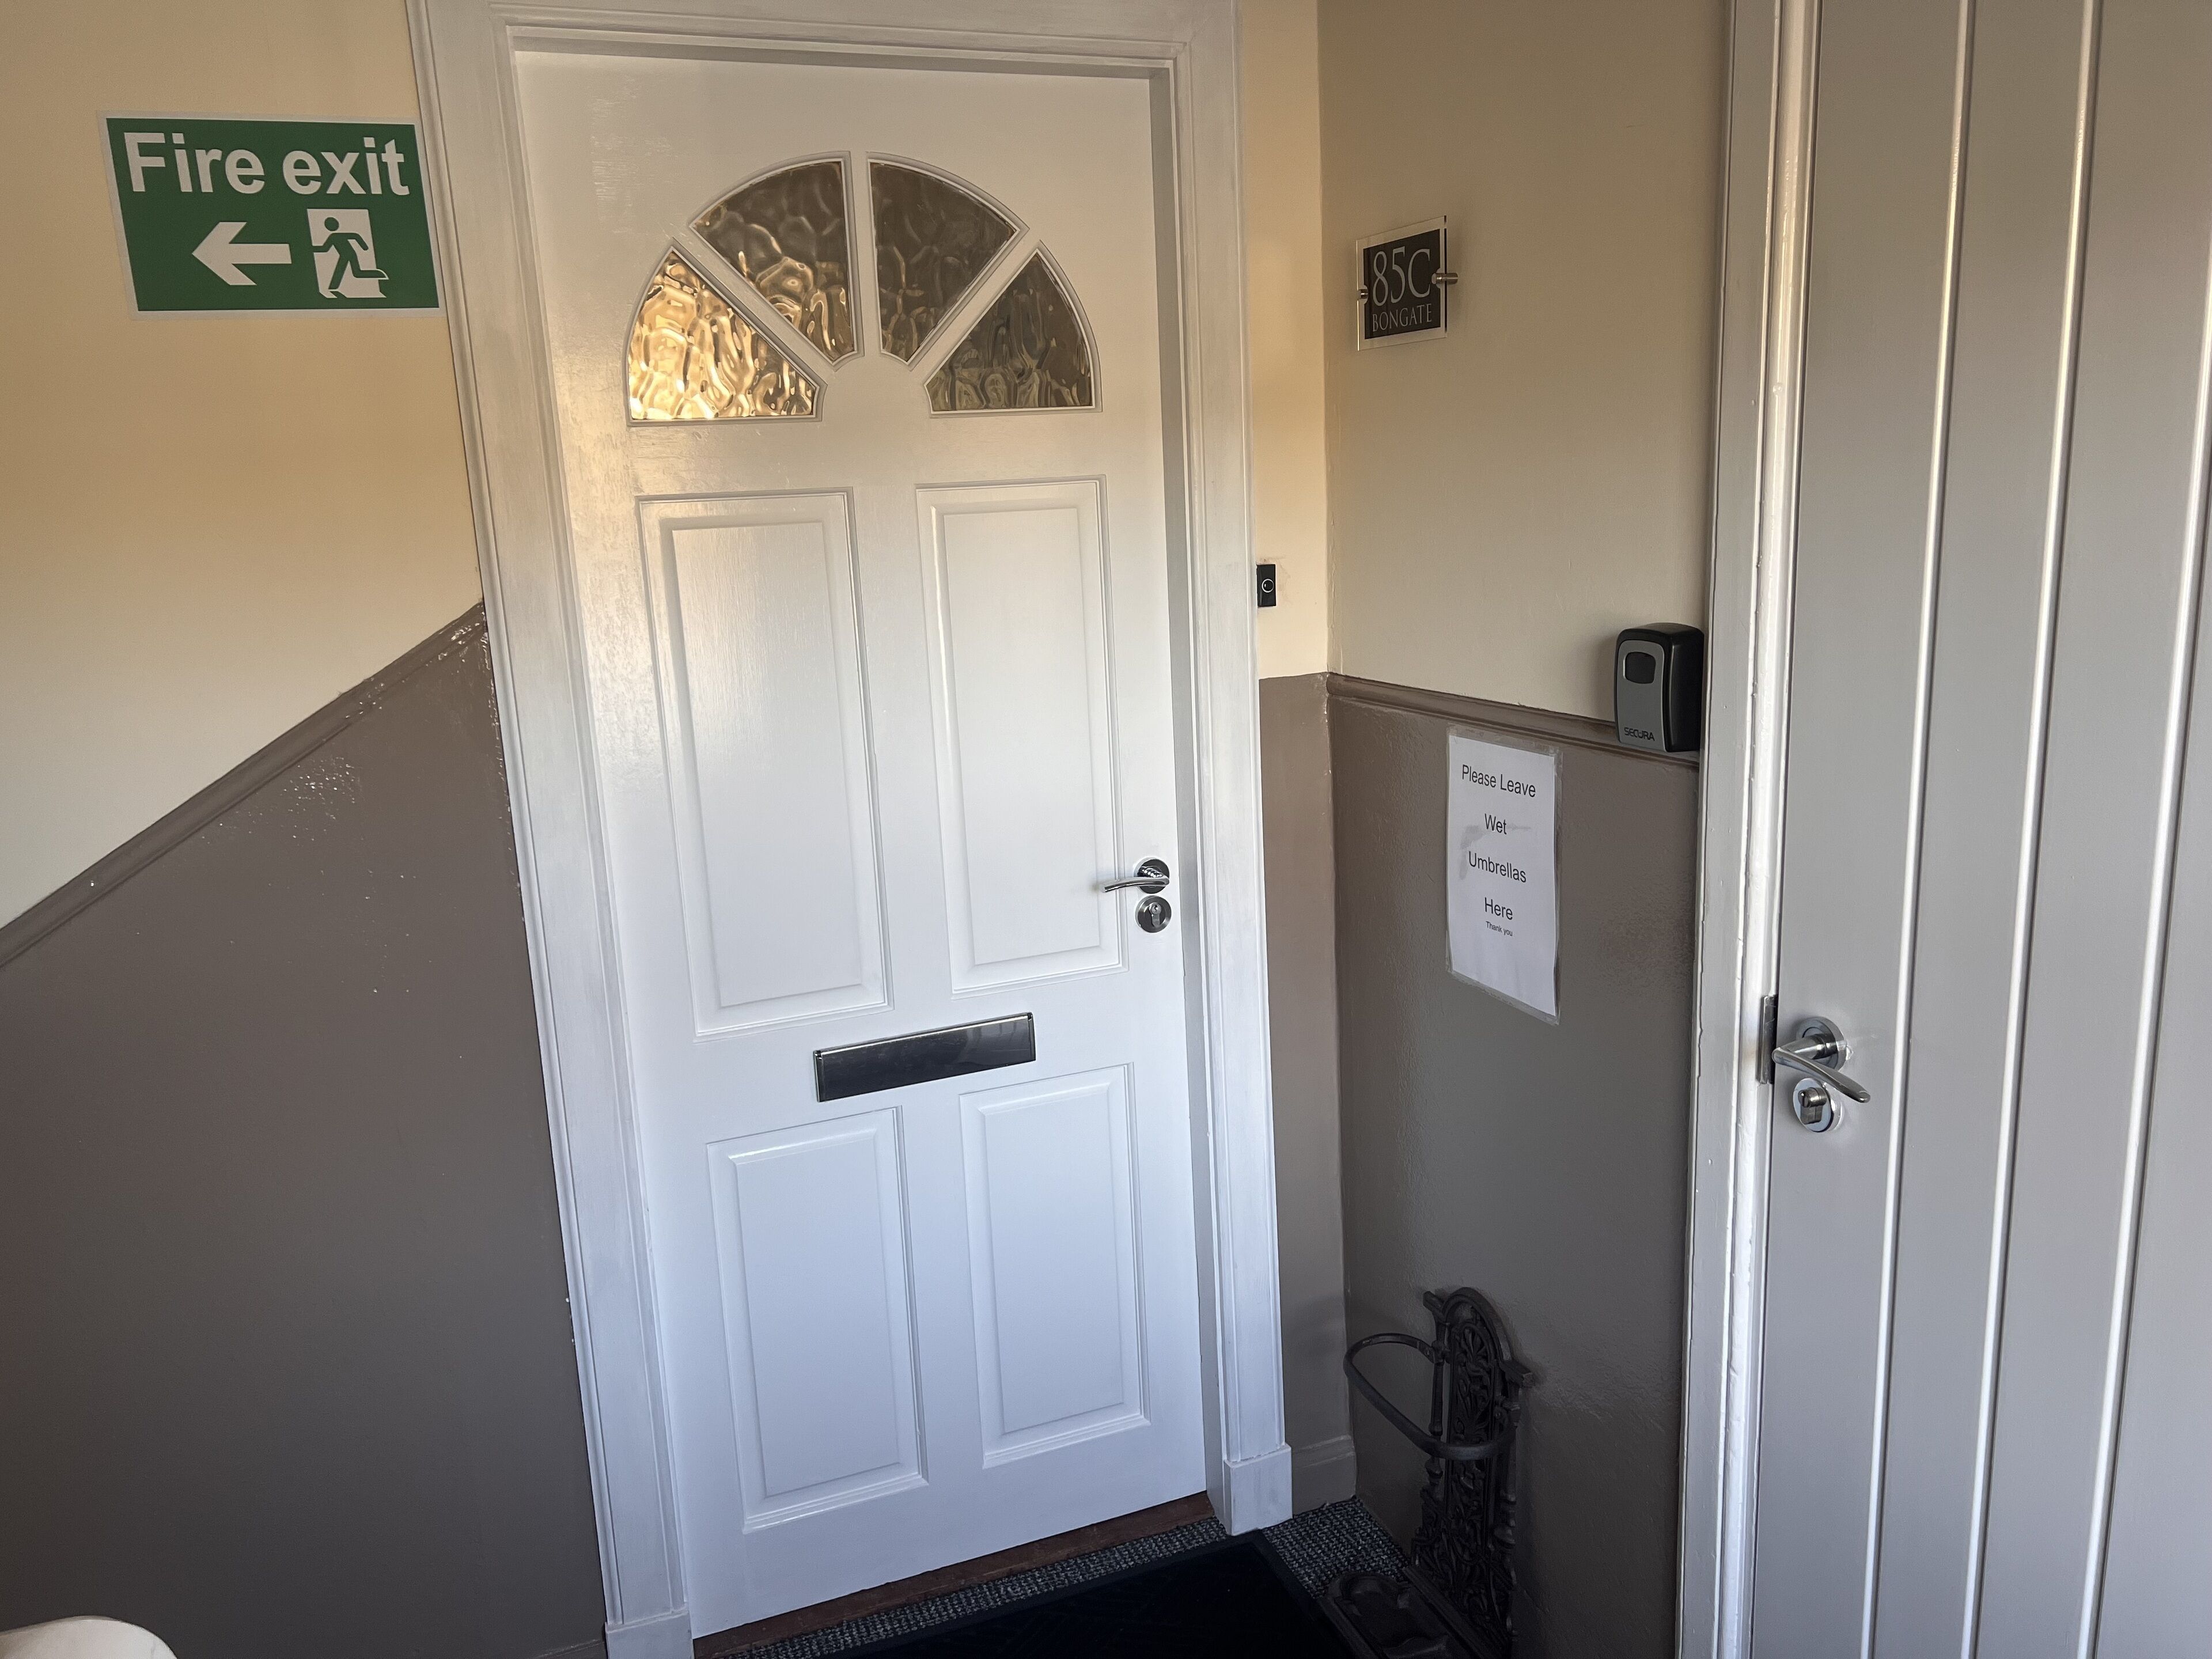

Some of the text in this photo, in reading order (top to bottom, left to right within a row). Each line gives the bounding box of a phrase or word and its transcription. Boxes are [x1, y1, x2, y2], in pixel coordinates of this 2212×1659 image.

[124, 132, 410, 195] Fire exit
[1373, 246, 1431, 306] 85C
[1373, 304, 1432, 332] BONGATE
[1624, 727, 1655, 741] SECURA
[1462, 764, 1536, 797] Please Leave
[1484, 813, 1507, 835] Wet
[1469, 851, 1527, 882] Umbrellas
[1484, 897, 1513, 920] Here
[1486, 921, 1513, 937] Thank you
